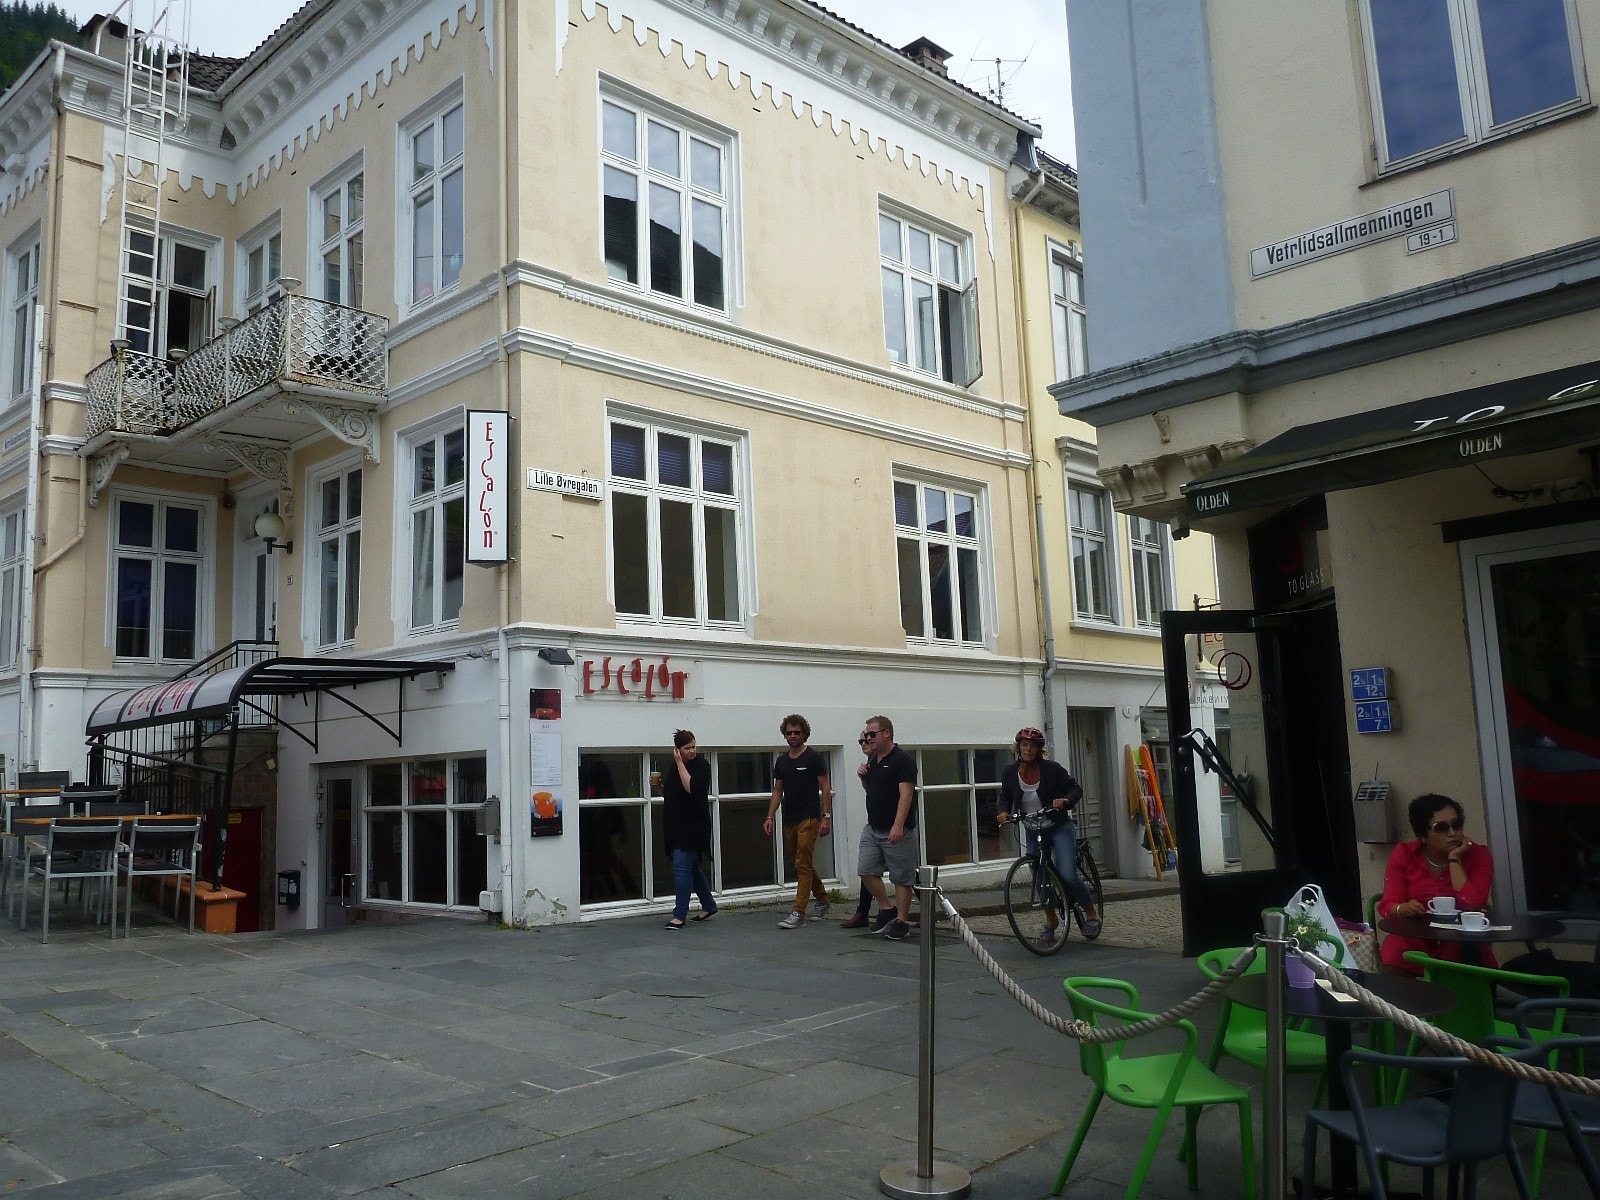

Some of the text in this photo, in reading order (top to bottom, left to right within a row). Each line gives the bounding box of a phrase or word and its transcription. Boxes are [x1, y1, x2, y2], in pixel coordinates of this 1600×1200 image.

[1266, 201, 1434, 265] Vetrlidsallmenningen
[1411, 405, 1506, 432] TO
[1459, 432, 1502, 457] OLDEN
[534, 472, 598, 494] Lille Øvregaten
[1196, 490, 1230, 512] OLDEN
[1287, 567, 1325, 596] TO GLASS
[1353, 674, 1360, 685] 2
[1365, 685, 1378, 696] 12
[1357, 706, 1364, 717] 2
[1374, 719, 1382, 730] 7
